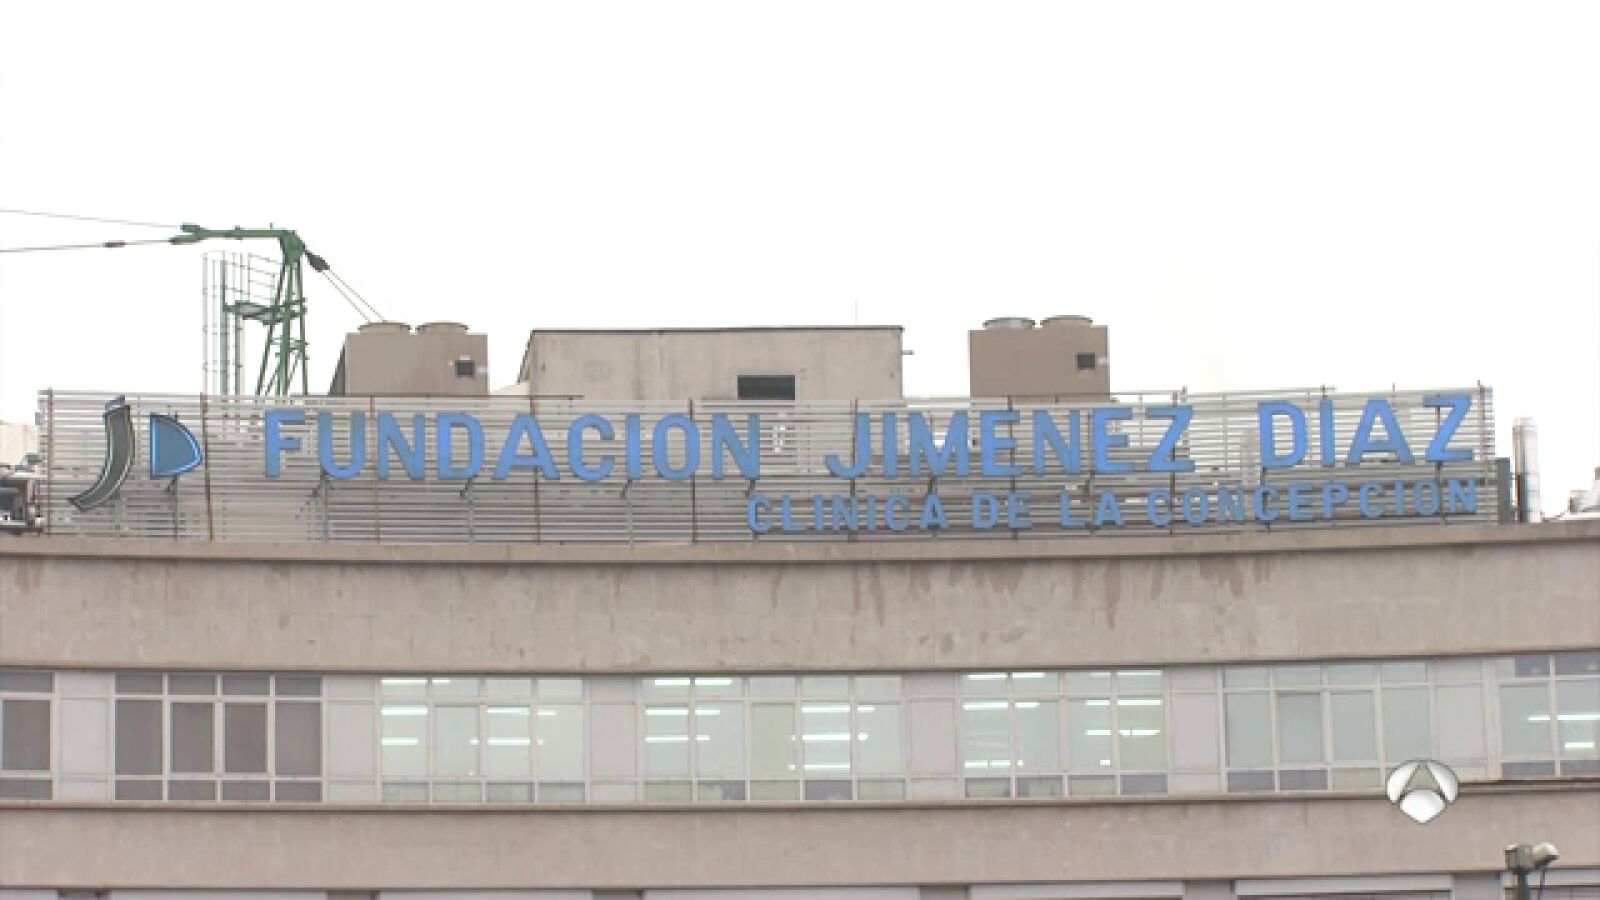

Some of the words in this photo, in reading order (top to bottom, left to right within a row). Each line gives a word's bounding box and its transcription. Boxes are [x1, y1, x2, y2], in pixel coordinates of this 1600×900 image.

[264, 408, 761, 481] FUNDACION
[825, 404, 1195, 478] JIMENEZ
[1257, 393, 1474, 469] DIAZ
[746, 493, 948, 534] CLINICA
[971, 491, 1033, 530] DE
[1059, 490, 1125, 528] LA
[1145, 477, 1478, 528] CONCEPCION
